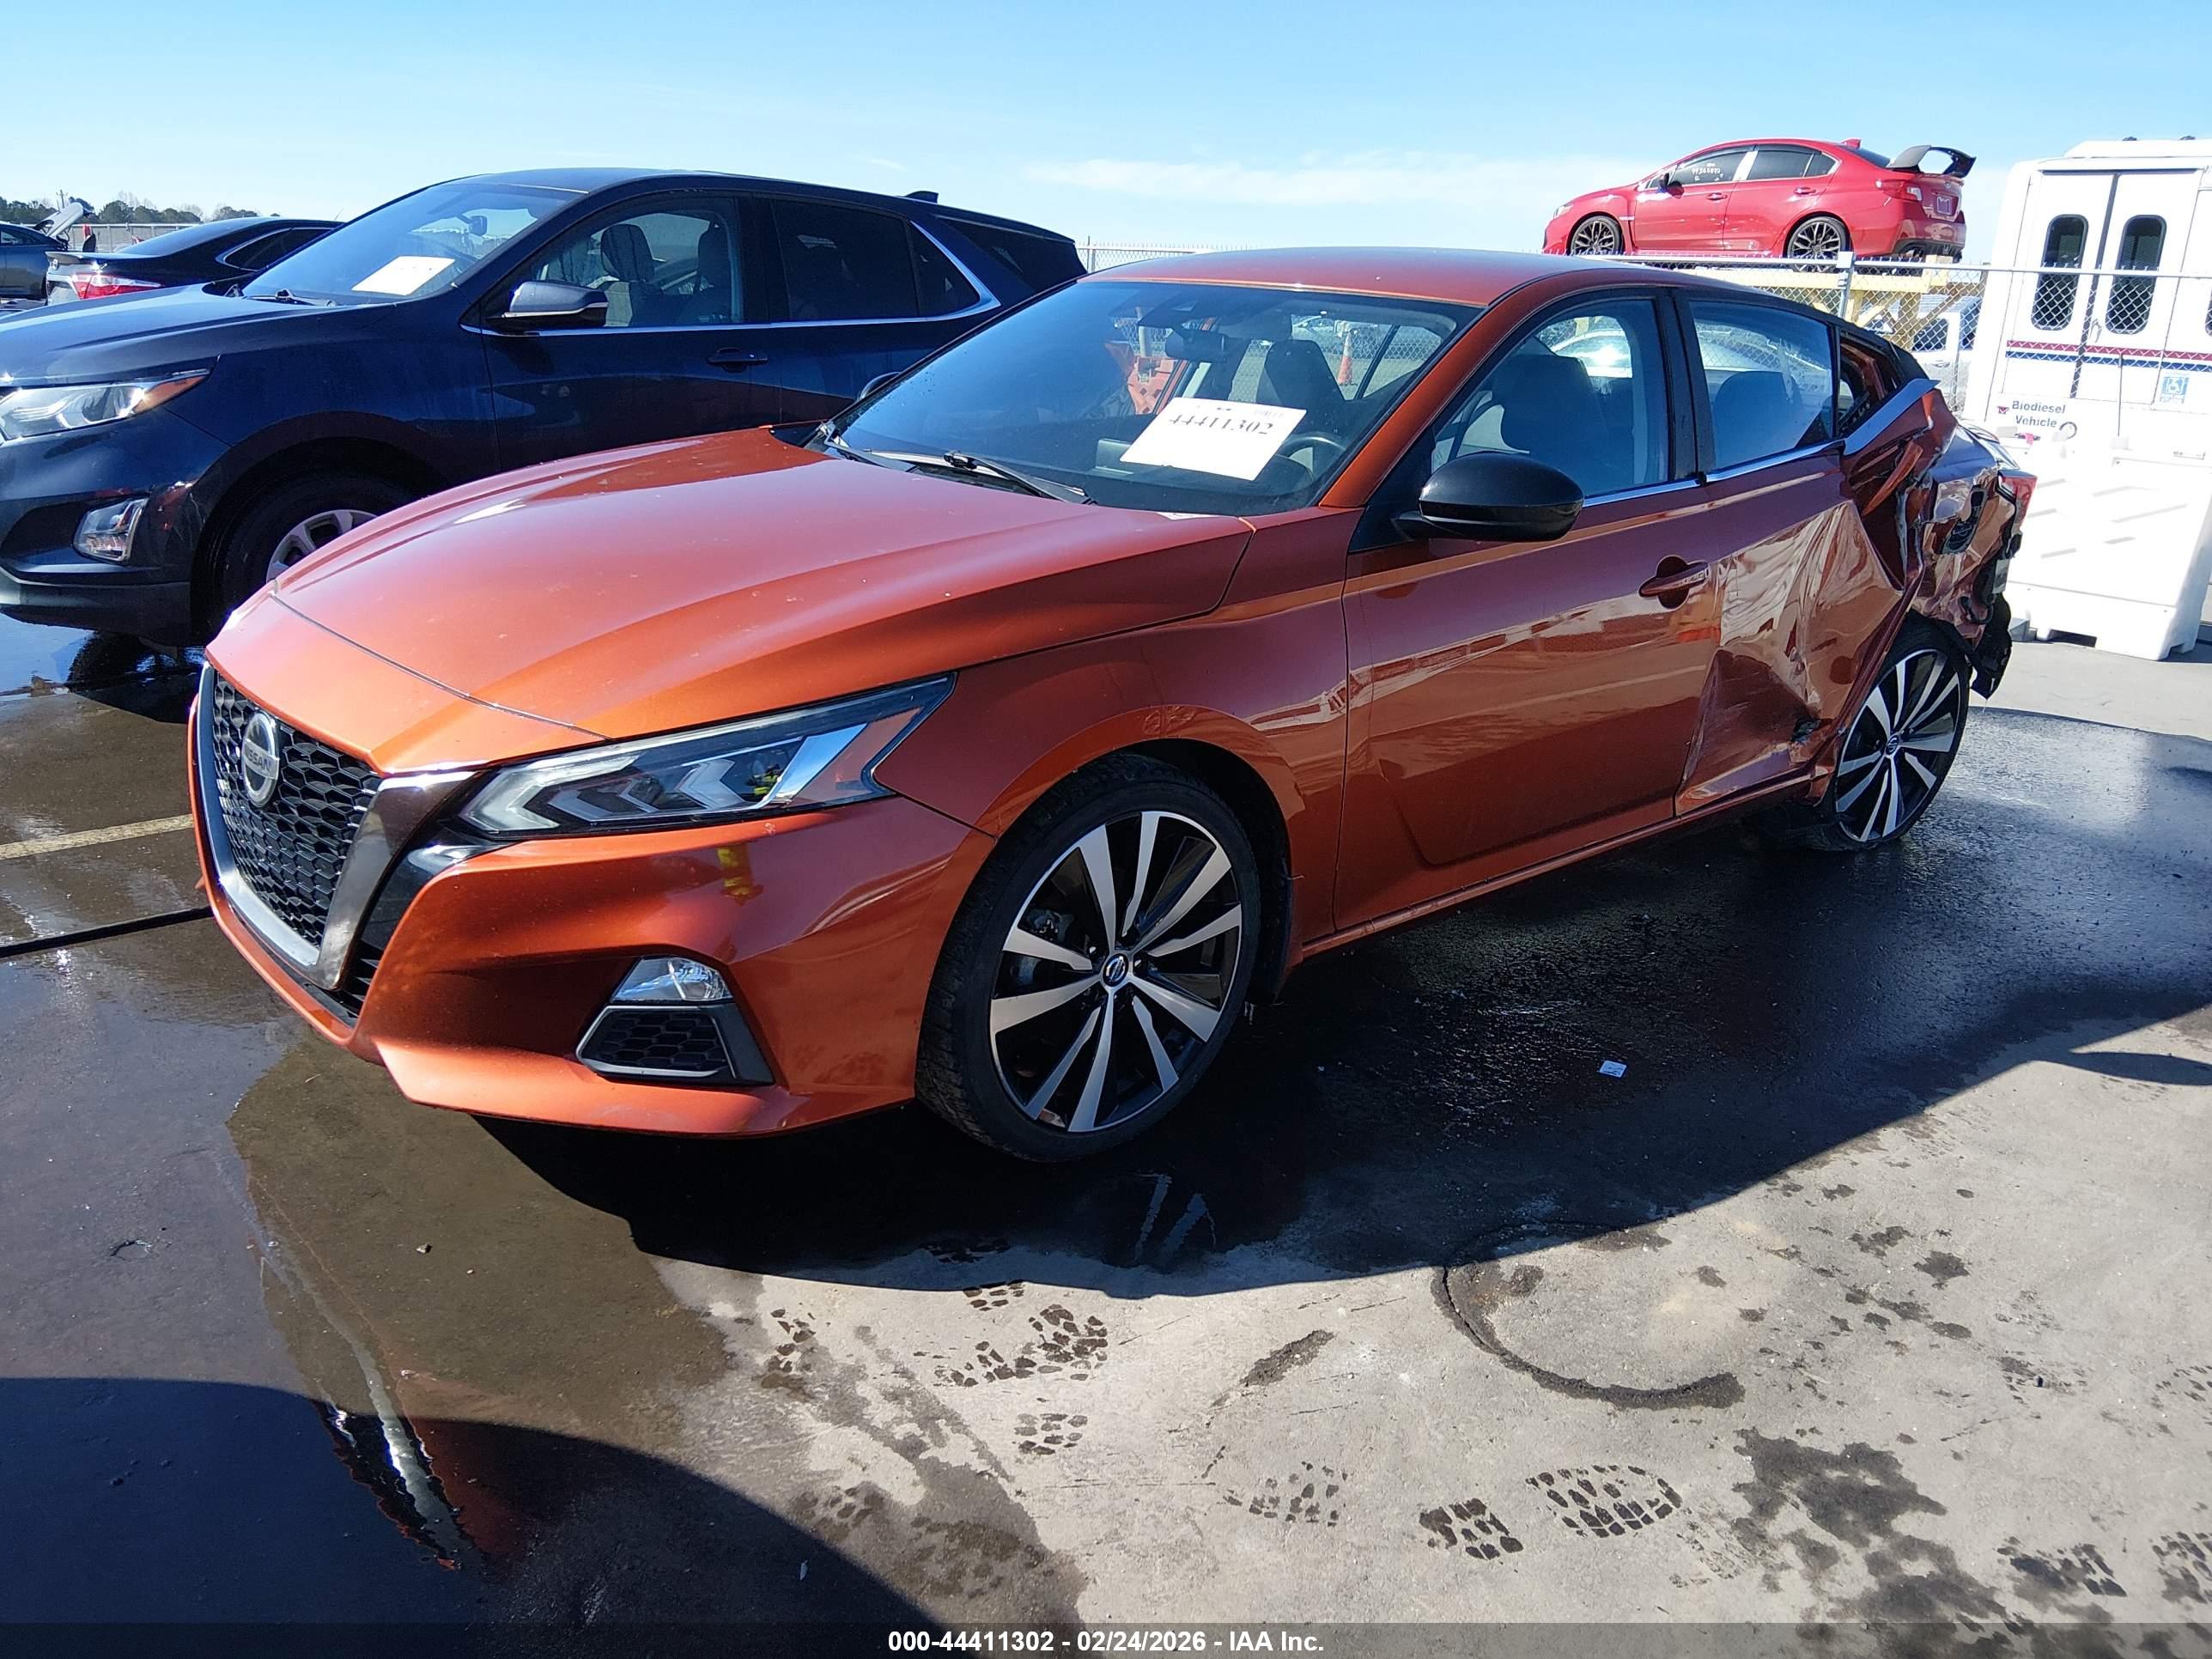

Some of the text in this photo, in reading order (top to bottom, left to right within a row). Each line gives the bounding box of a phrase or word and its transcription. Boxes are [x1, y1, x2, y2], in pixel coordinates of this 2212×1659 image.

[2012, 400, 2066, 414] Biodiesel
[1169, 414, 1273, 434] 44411302
[2015, 415, 2057, 428] Vehicle
